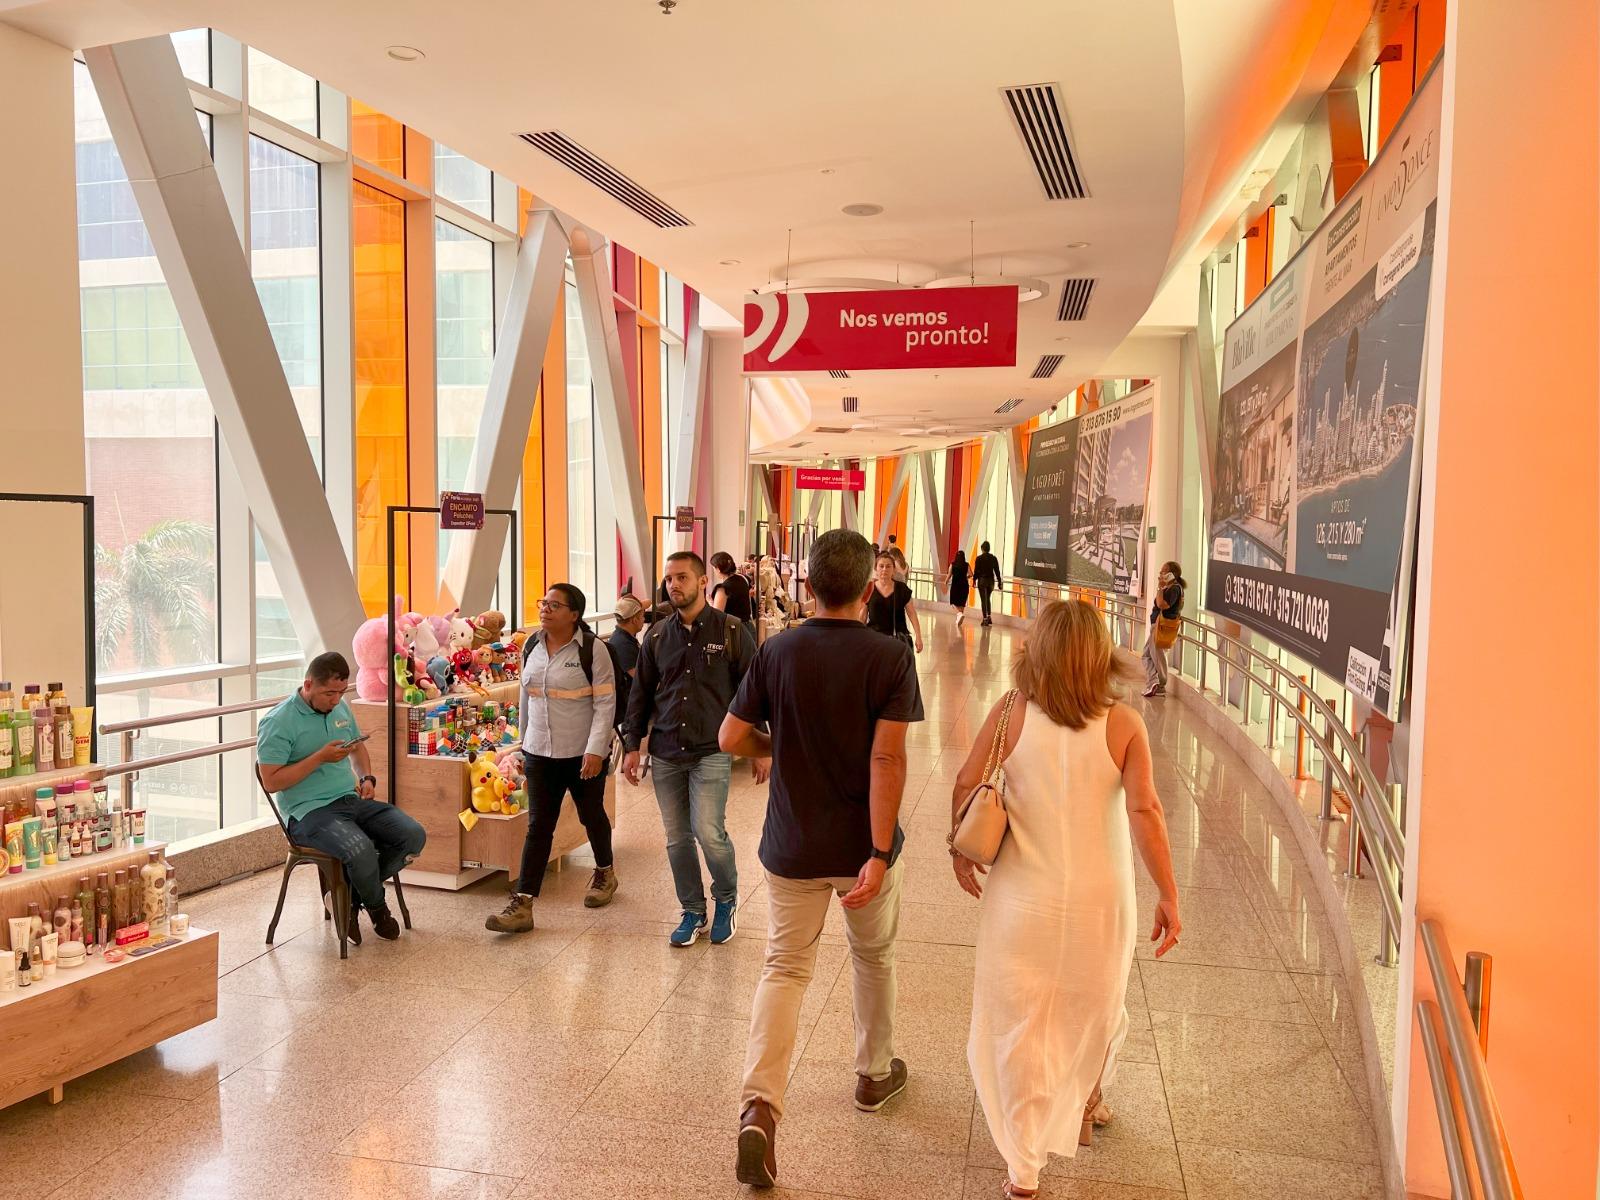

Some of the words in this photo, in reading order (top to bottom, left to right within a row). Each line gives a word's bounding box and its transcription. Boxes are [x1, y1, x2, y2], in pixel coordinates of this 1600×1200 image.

[840, 309, 878, 328] Nos
[882, 310, 948, 327] vemos
[906, 322, 989, 352] pronto!
[1085, 415, 1095, 431] 313
[1113, 406, 1121, 422] 90
[450, 502, 478, 511] ENCANTO
[1344, 520, 1356, 545] 280
[1232, 575, 1245, 605] 315
[1245, 578, 1256, 610] 731
[1256, 580, 1274, 617] 6747
[1277, 586, 1291, 624] 315
[1291, 590, 1304, 631] 721
[1305, 594, 1329, 643] 0038
